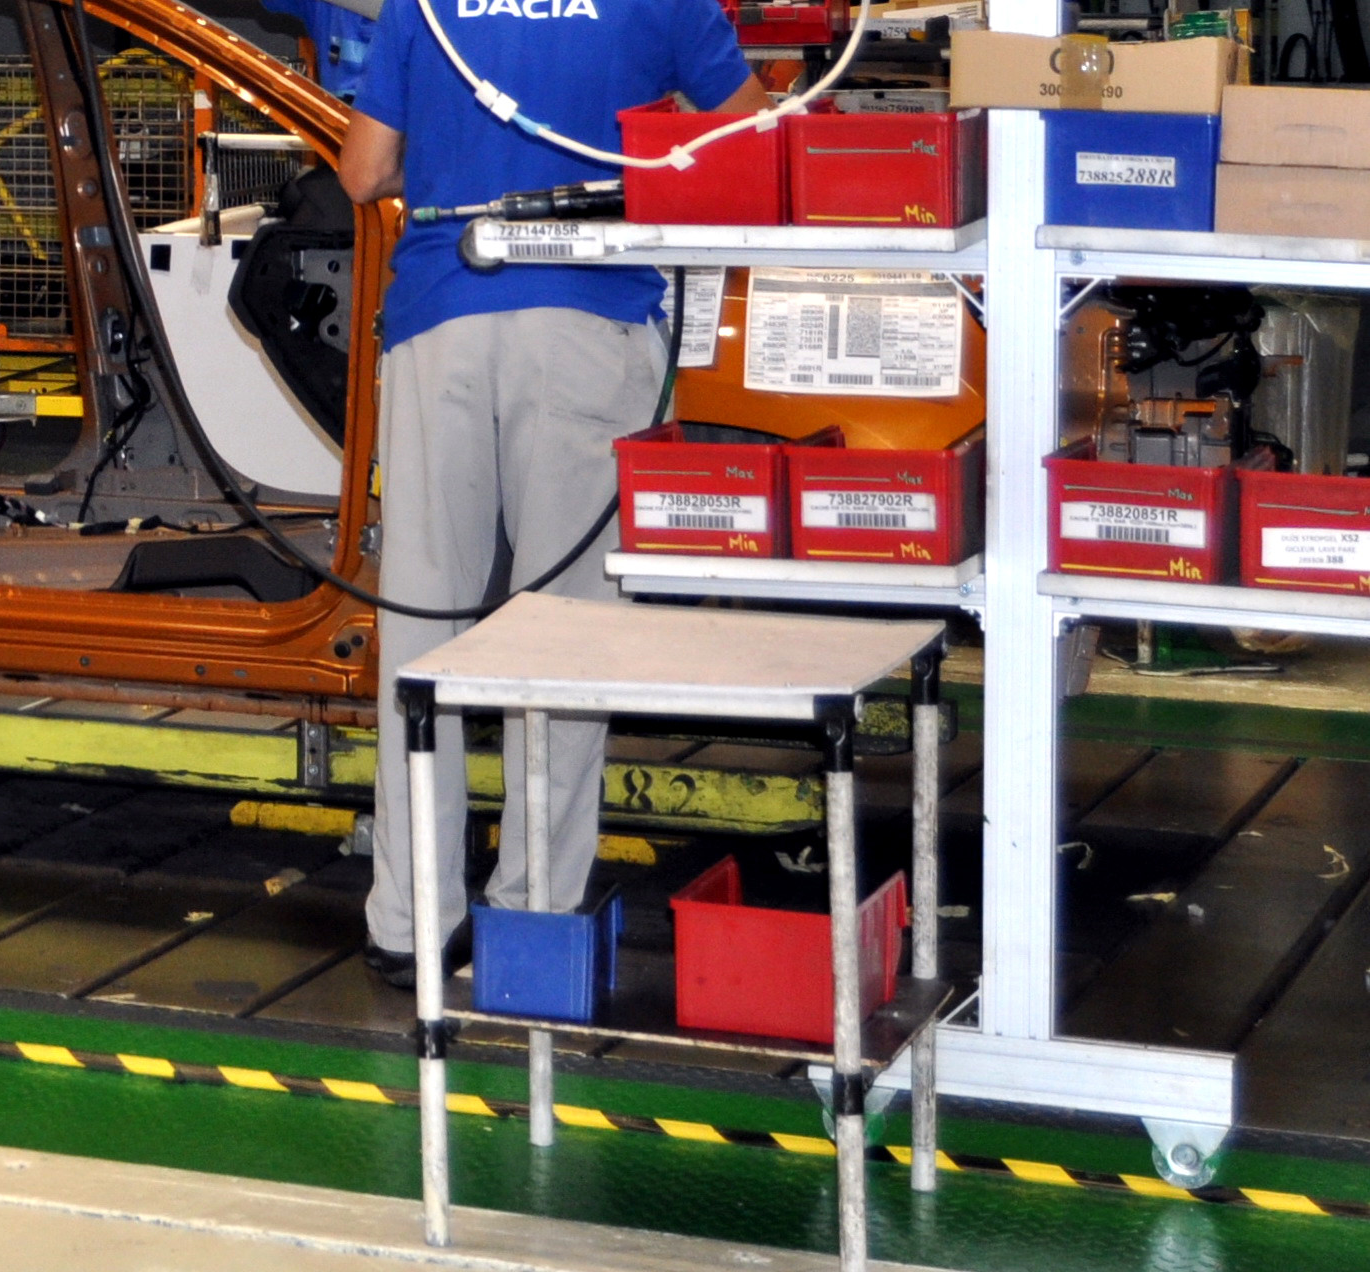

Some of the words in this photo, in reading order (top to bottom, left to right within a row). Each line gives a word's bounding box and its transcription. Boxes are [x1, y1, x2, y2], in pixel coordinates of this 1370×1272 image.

[904, 204, 937, 224] Min
[725, 466, 755, 479] Max
[897, 471, 922, 485] Max
[659, 493, 741, 508] 738828053R
[829, 492, 913, 507] 738827902R
[1167, 488, 1193, 501] Max
[1089, 504, 1178, 523] 738820851R
[729, 534, 758, 552] Min
[901, 542, 932, 561] Min
[1169, 557, 1202, 580] Min
